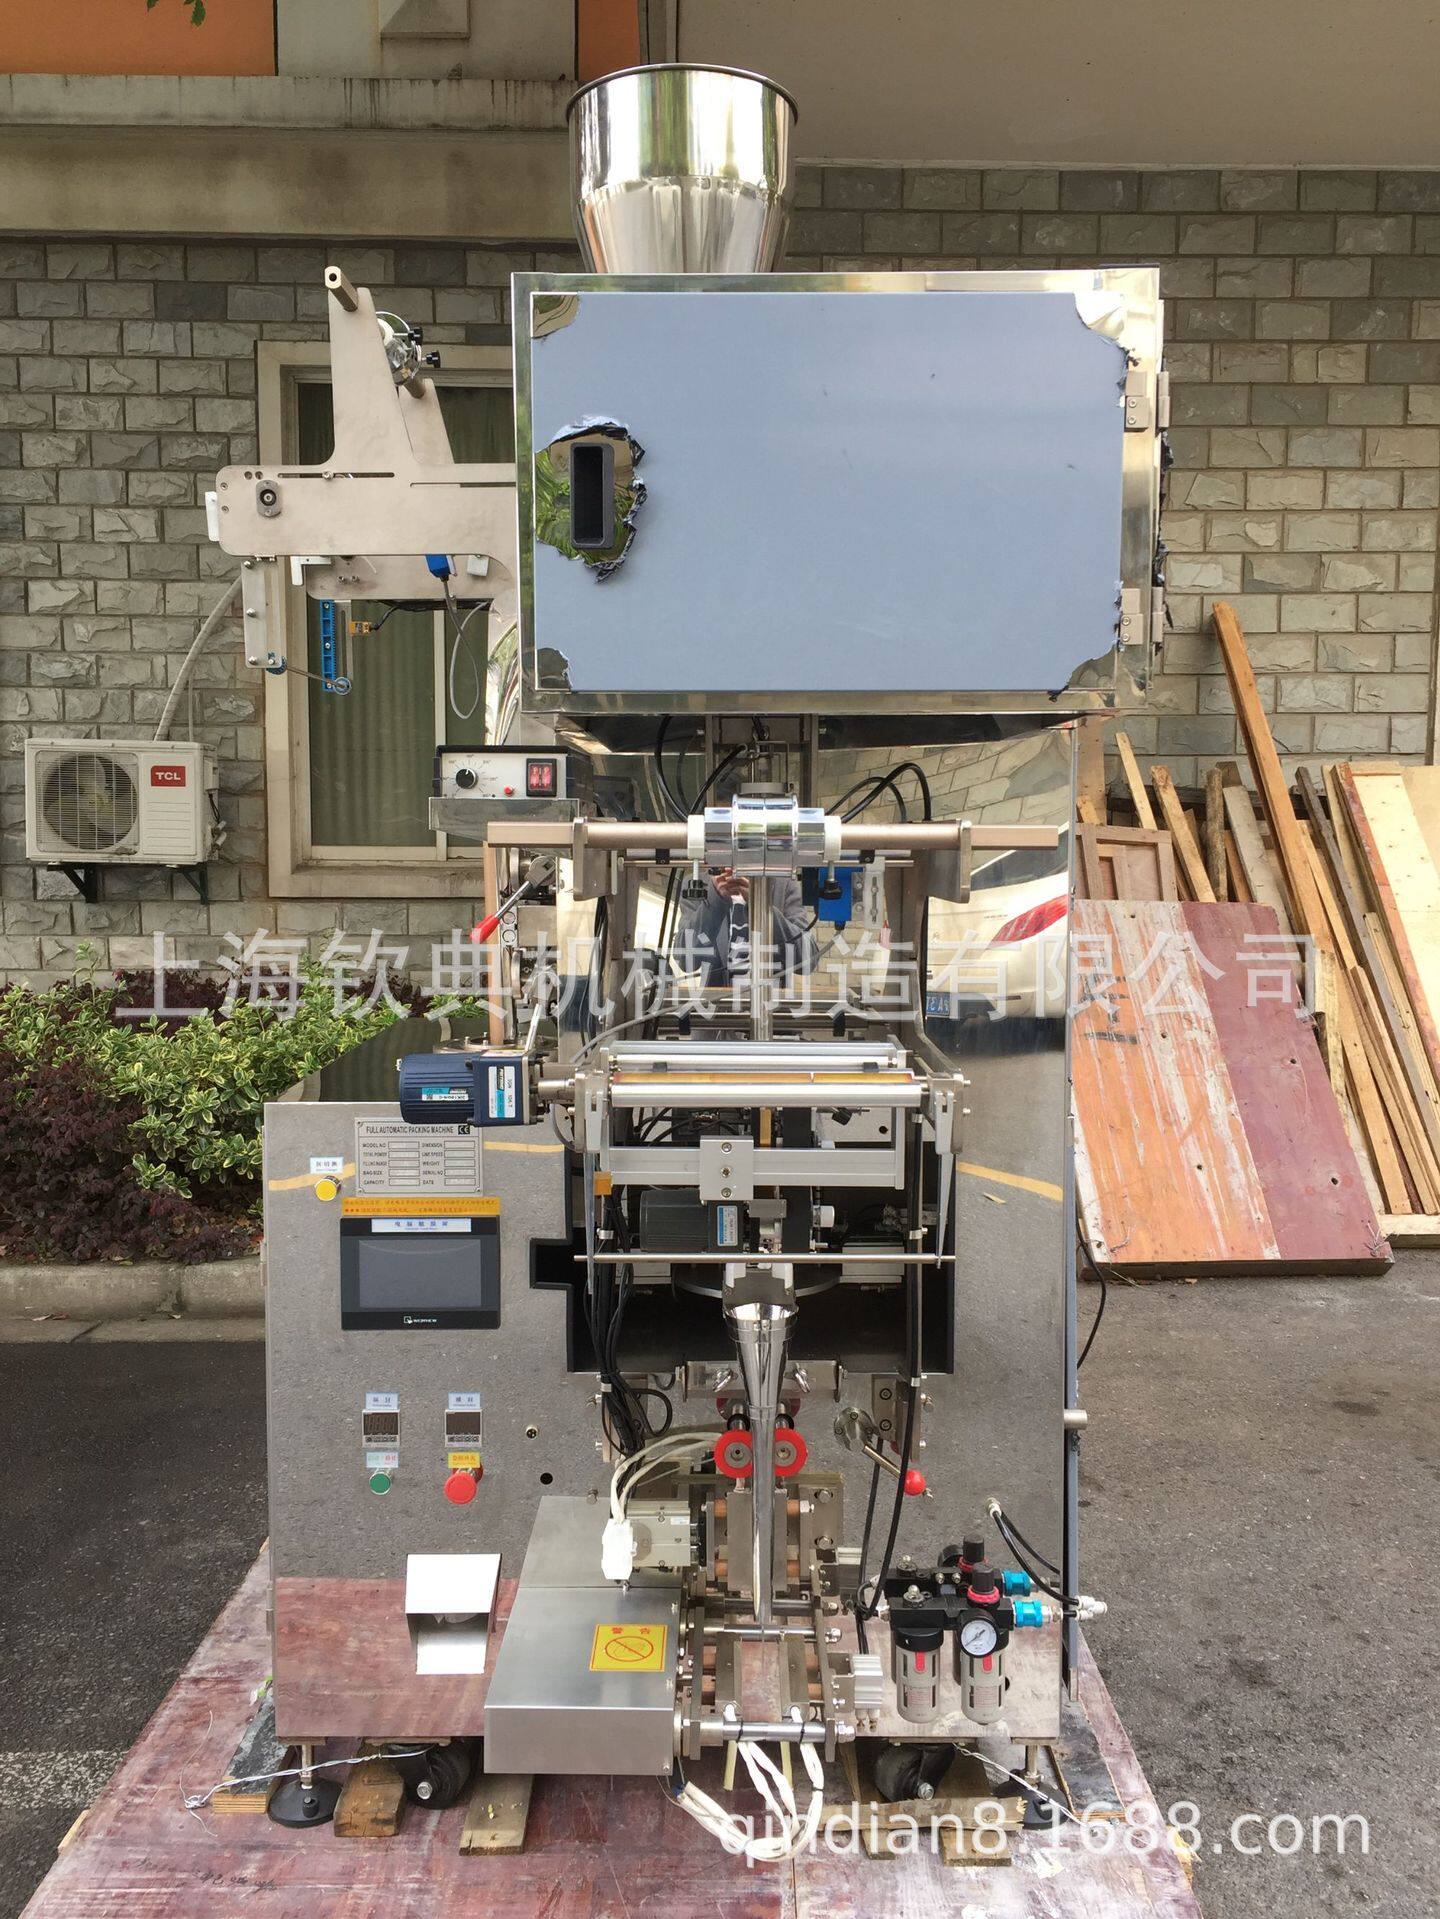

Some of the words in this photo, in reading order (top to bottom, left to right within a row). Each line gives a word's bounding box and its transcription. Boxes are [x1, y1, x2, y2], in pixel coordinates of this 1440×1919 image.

[156, 771, 181, 780] TCL
[380, 1125, 408, 1134] AUTOMATIC
[408, 1125, 431, 1134] PACKING
[431, 1125, 454, 1134] MACHINE
